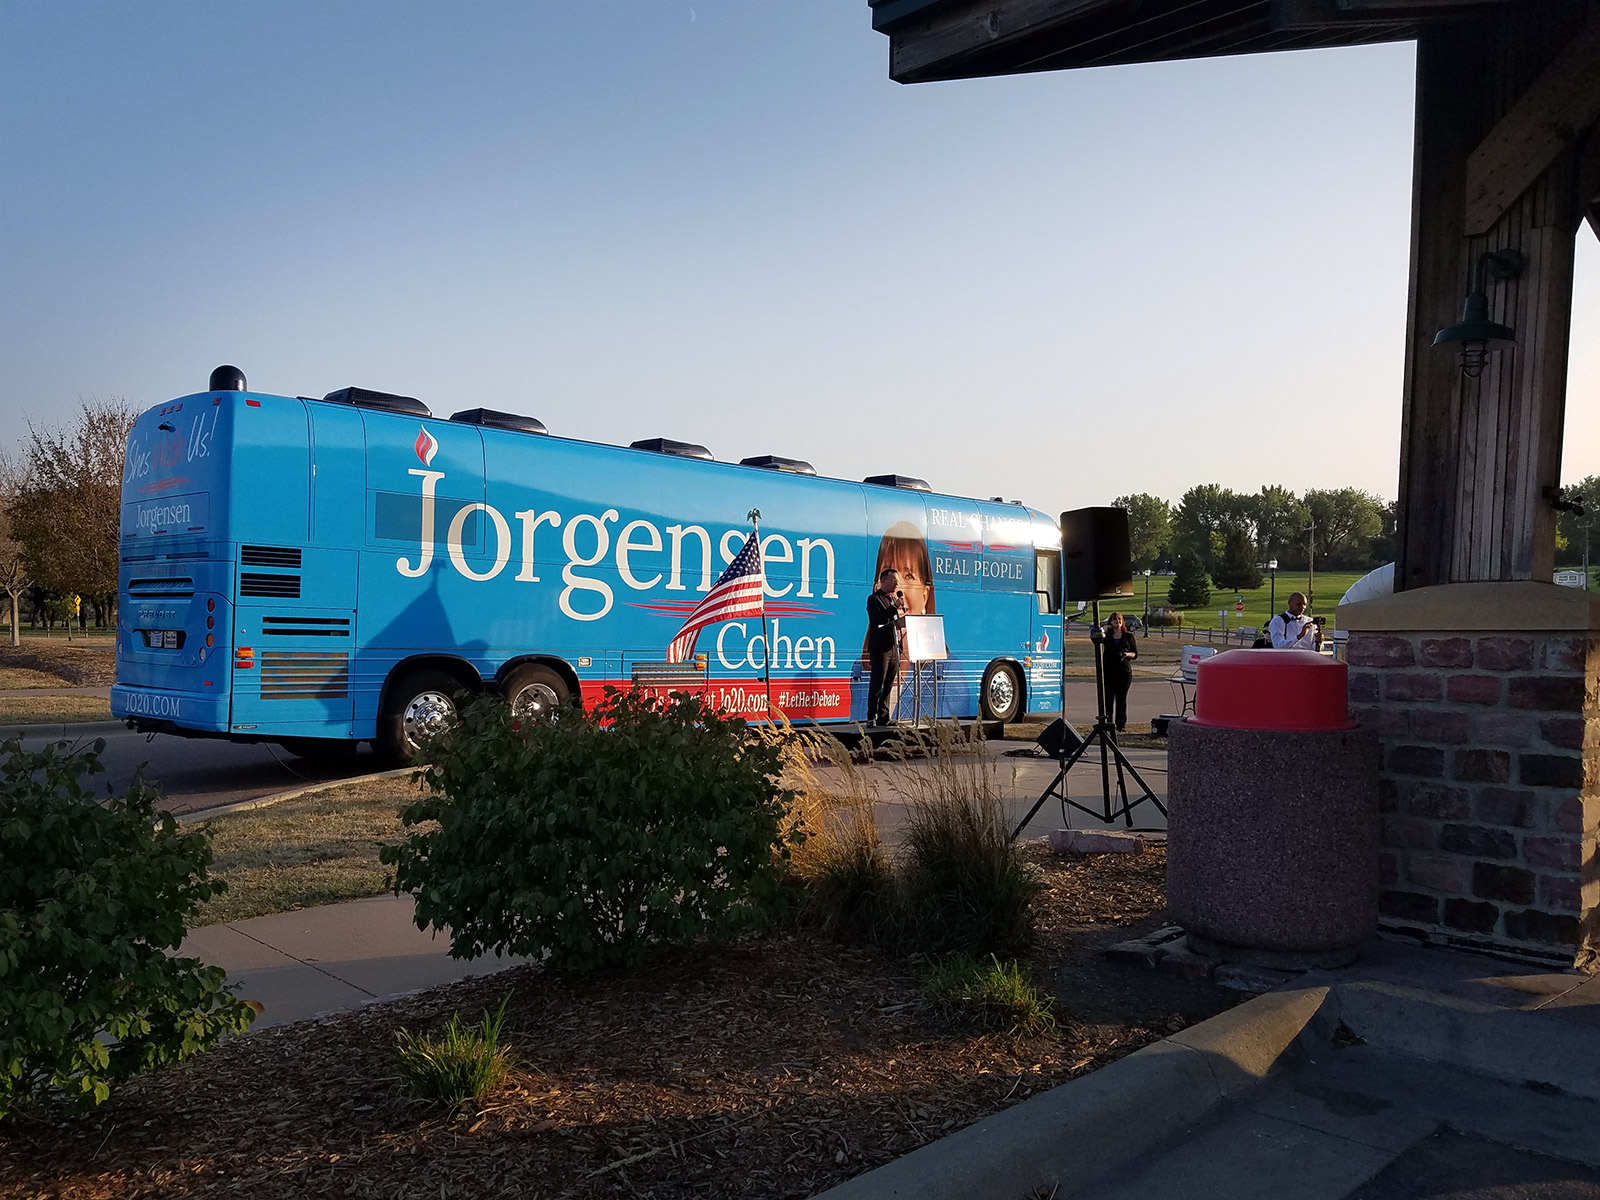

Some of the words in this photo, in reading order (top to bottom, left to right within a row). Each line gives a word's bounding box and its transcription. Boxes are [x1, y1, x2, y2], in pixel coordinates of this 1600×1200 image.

[126, 432, 151, 484] She's
[187, 406, 219, 462] Us!
[136, 503, 190, 533] Jorgensen
[931, 508, 967, 528] REAL
[935, 557, 970, 576] REAL
[974, 560, 1023, 580] PEOPLE
[138, 610, 177, 619] PREVOST
[716, 618, 837, 670] Cohen
[125, 692, 180, 717] JO20.COM
[778, 690, 840, 708] #LetHerDebate
